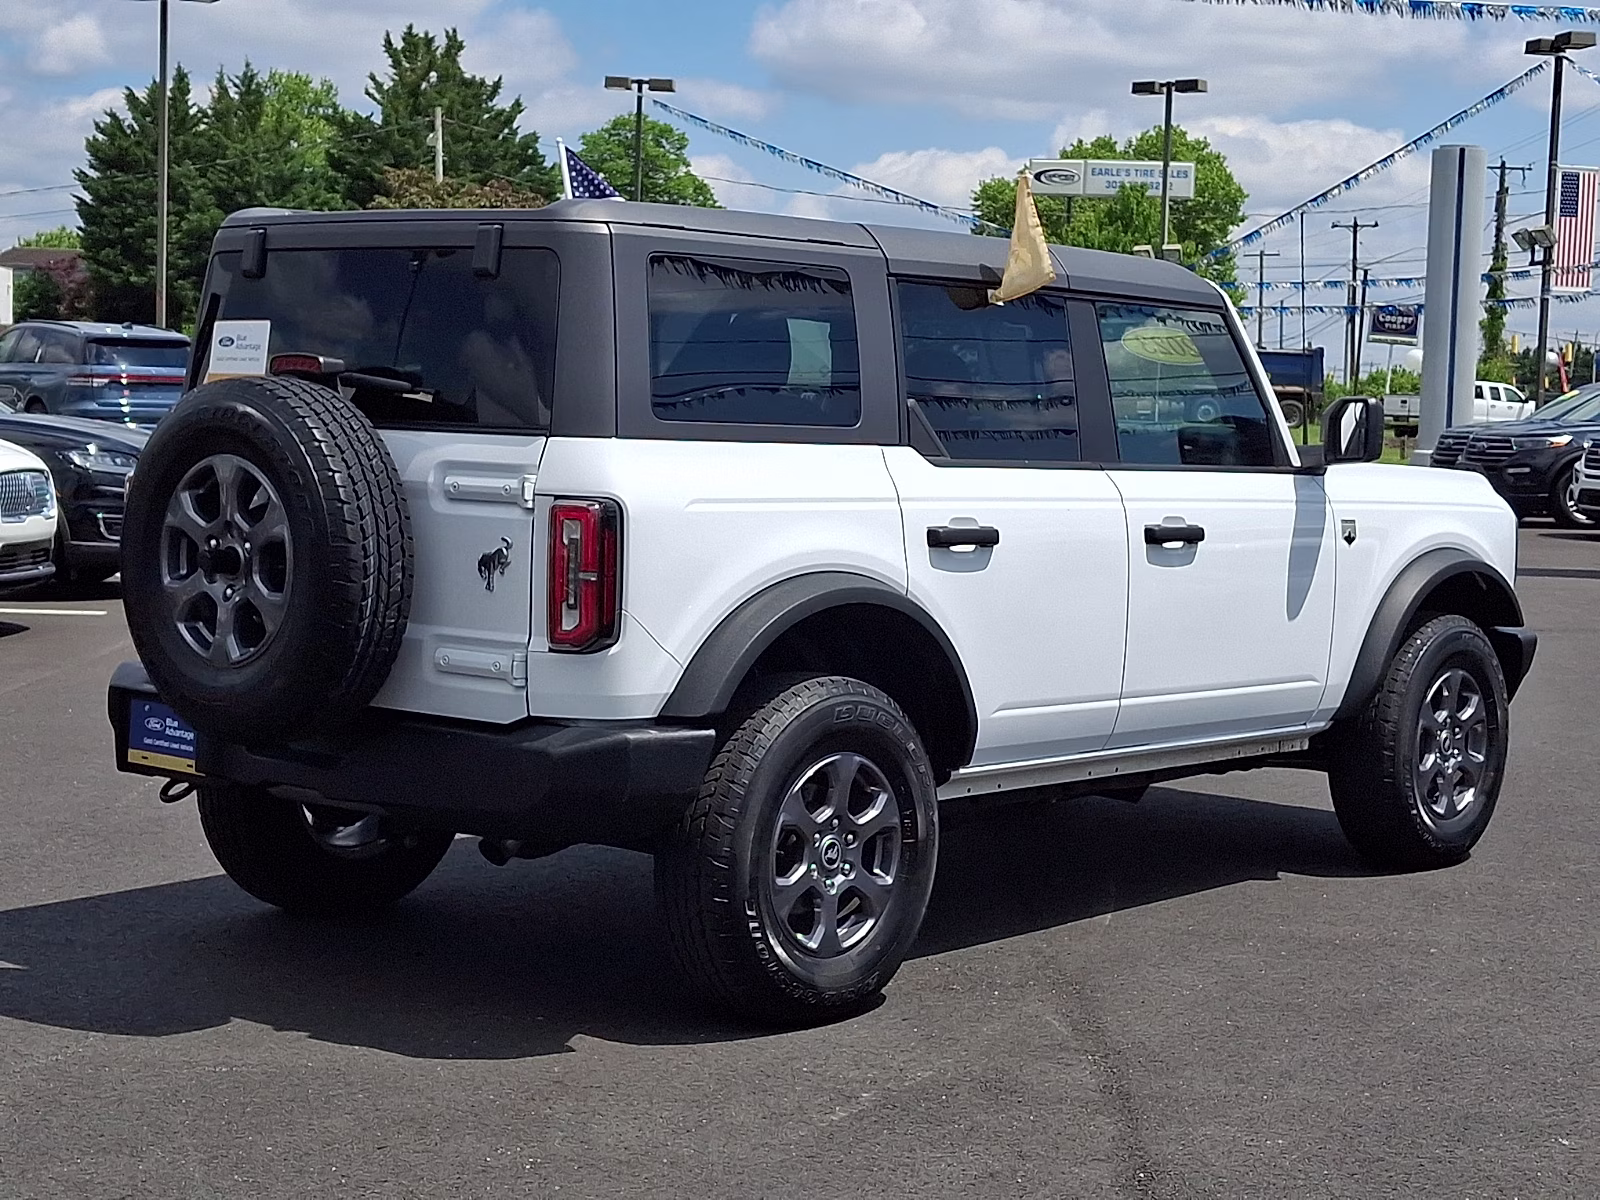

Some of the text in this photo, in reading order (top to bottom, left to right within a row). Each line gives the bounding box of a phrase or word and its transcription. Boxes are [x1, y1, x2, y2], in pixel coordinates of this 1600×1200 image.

[1091, 167, 1189, 179] EARLE'S TIRE SLES
[1379, 313, 1413, 325] Cooper
[146, 718, 163, 730] Ford
[166, 718, 179, 727] Blue
[165, 727, 194, 740] Advantage
